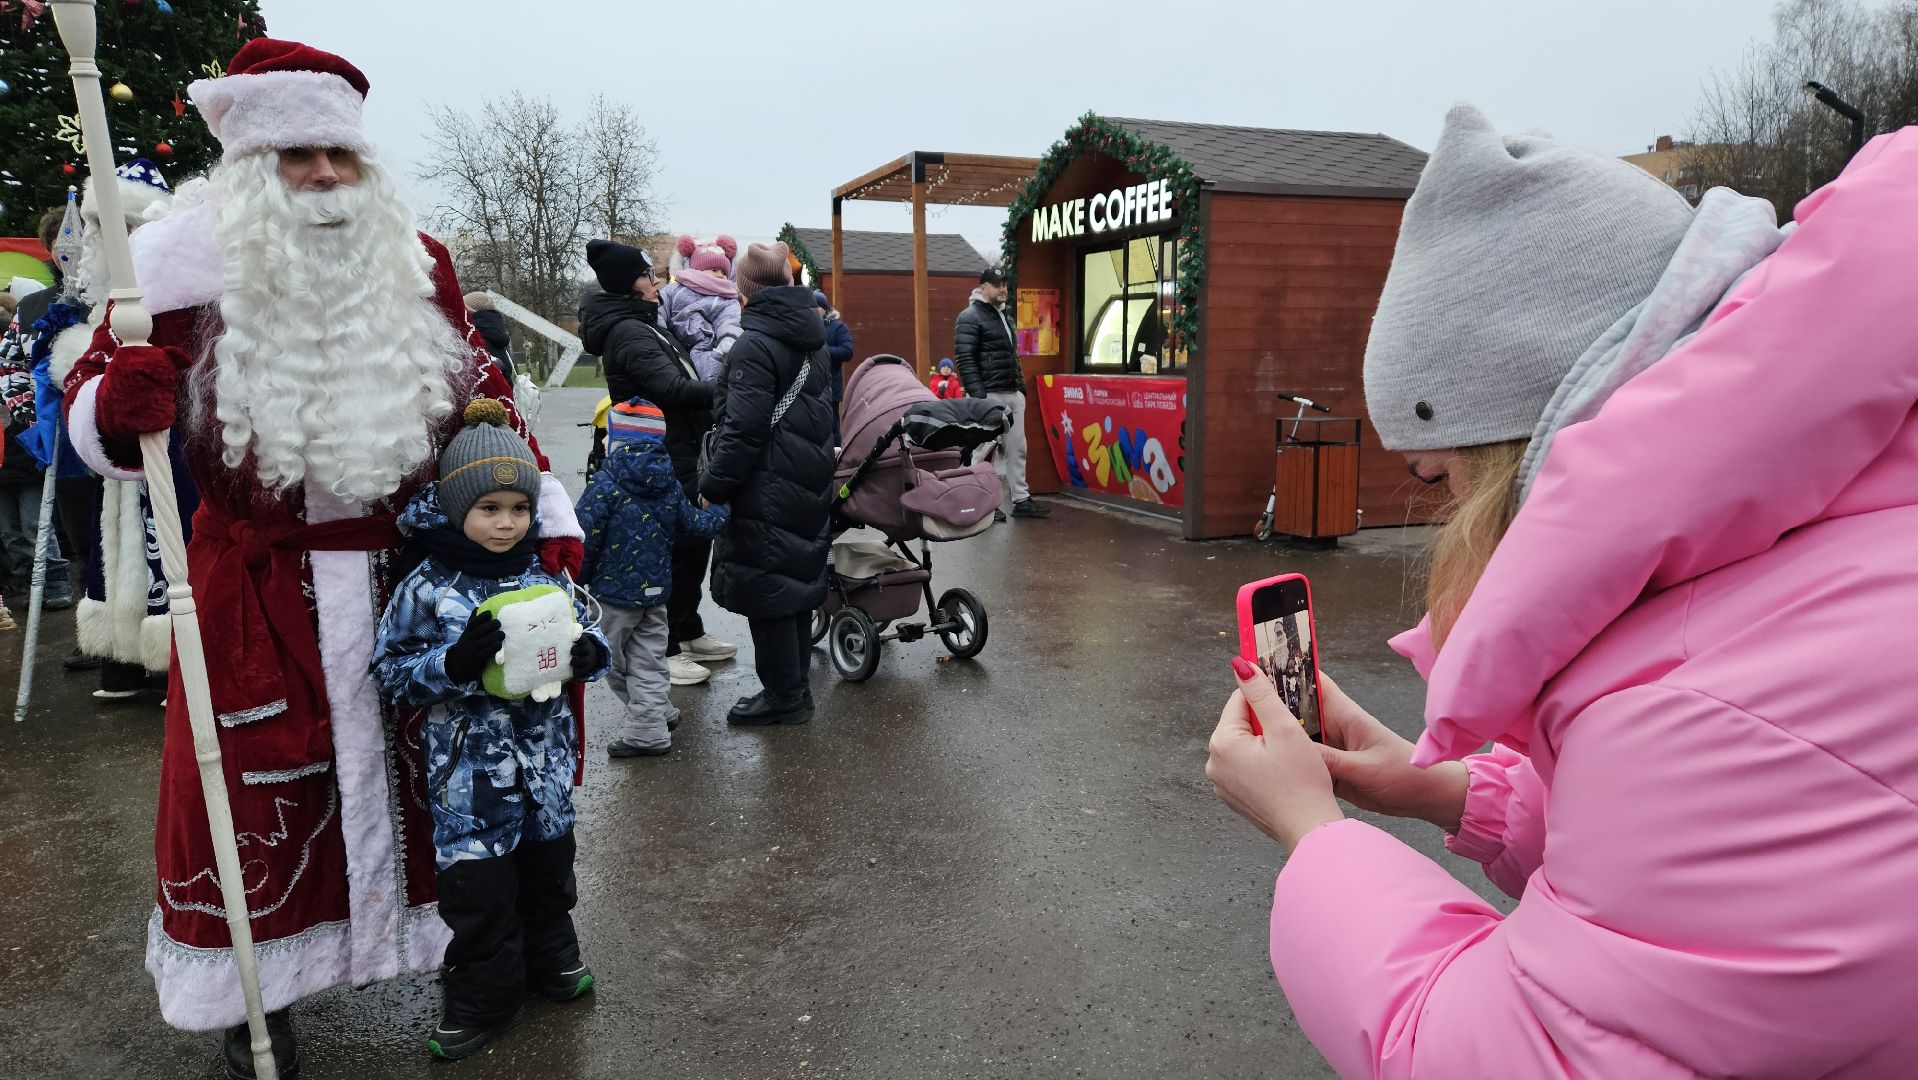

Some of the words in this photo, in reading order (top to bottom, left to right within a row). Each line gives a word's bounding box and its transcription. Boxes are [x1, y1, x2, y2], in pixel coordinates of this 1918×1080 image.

[1032, 198, 1085, 243] MAKE
[1089, 178, 1173, 233] COFFEE
[1143, 391, 1177, 401] ЦЕНТРАЛЬНЫЙ
[1144, 400, 1157, 409] ПАРК
[1157, 401, 1177, 411] ПОБЕДЫ
[537, 646, 557, 671] 胡
